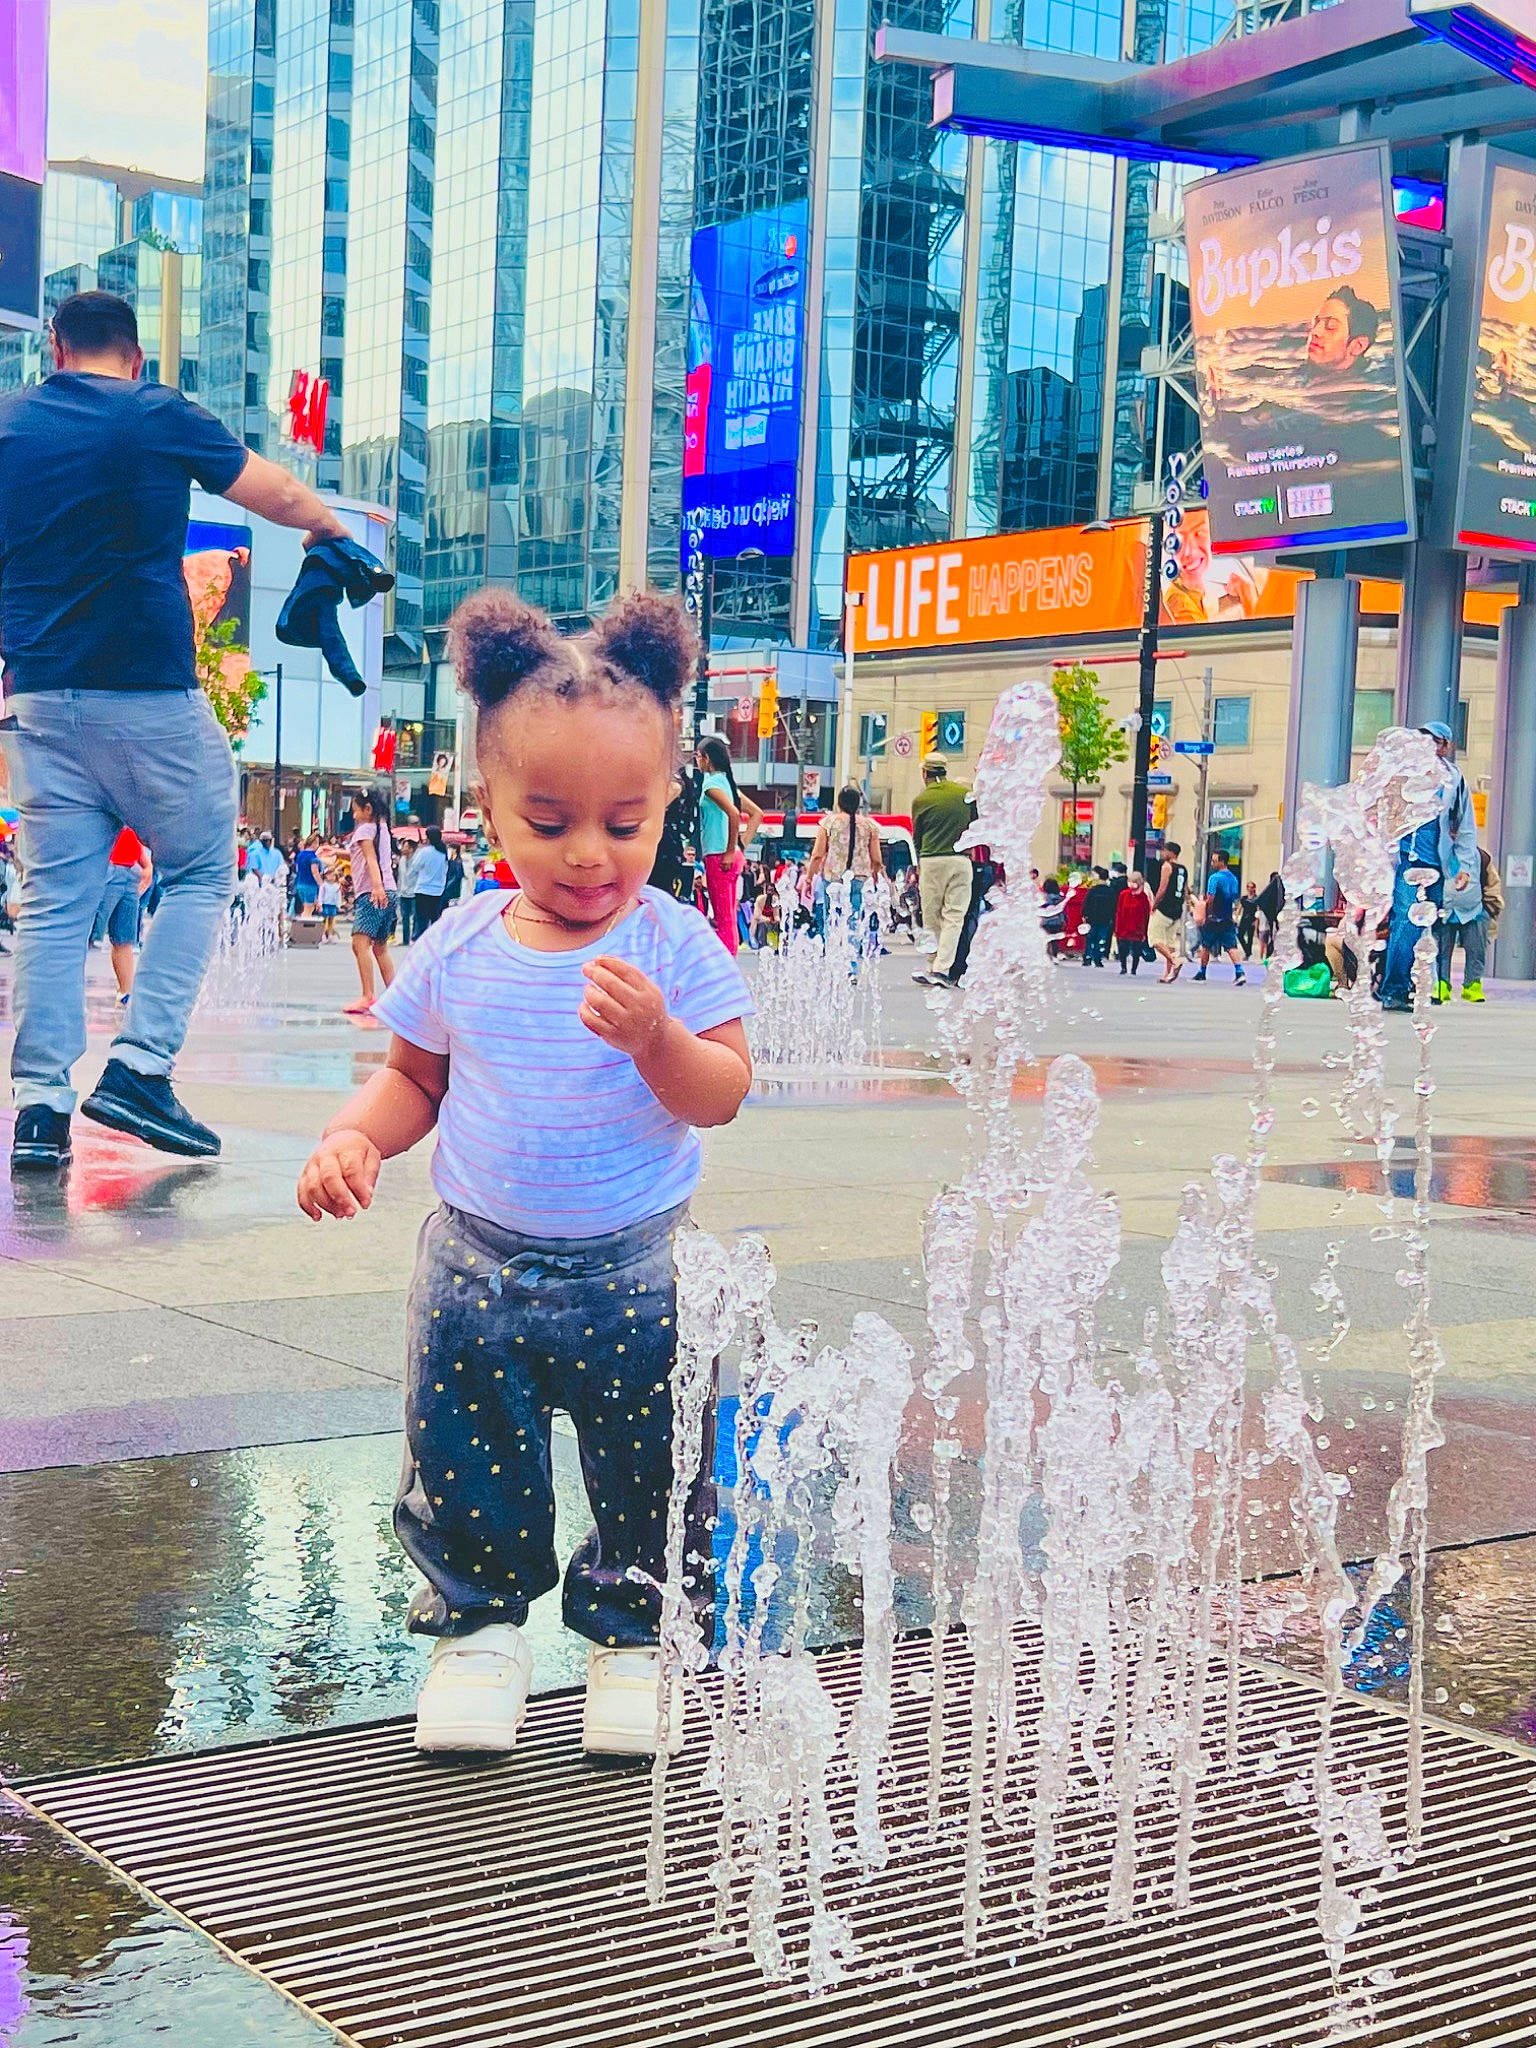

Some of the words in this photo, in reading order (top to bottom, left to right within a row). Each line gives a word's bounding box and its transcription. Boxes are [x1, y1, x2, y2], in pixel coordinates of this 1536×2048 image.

[1293, 187, 1330, 204] PESCI
[1250, 196, 1285, 214] FALCO
[1202, 206, 1242, 226] DAVIDSON
[1197, 216, 1364, 317] Bupkis
[1271, 456, 1326, 473] Thursday
[866, 552, 963, 642] LIFE
[967, 552, 1094, 617] HAPPENS
[1213, 804, 1233, 819] fido
